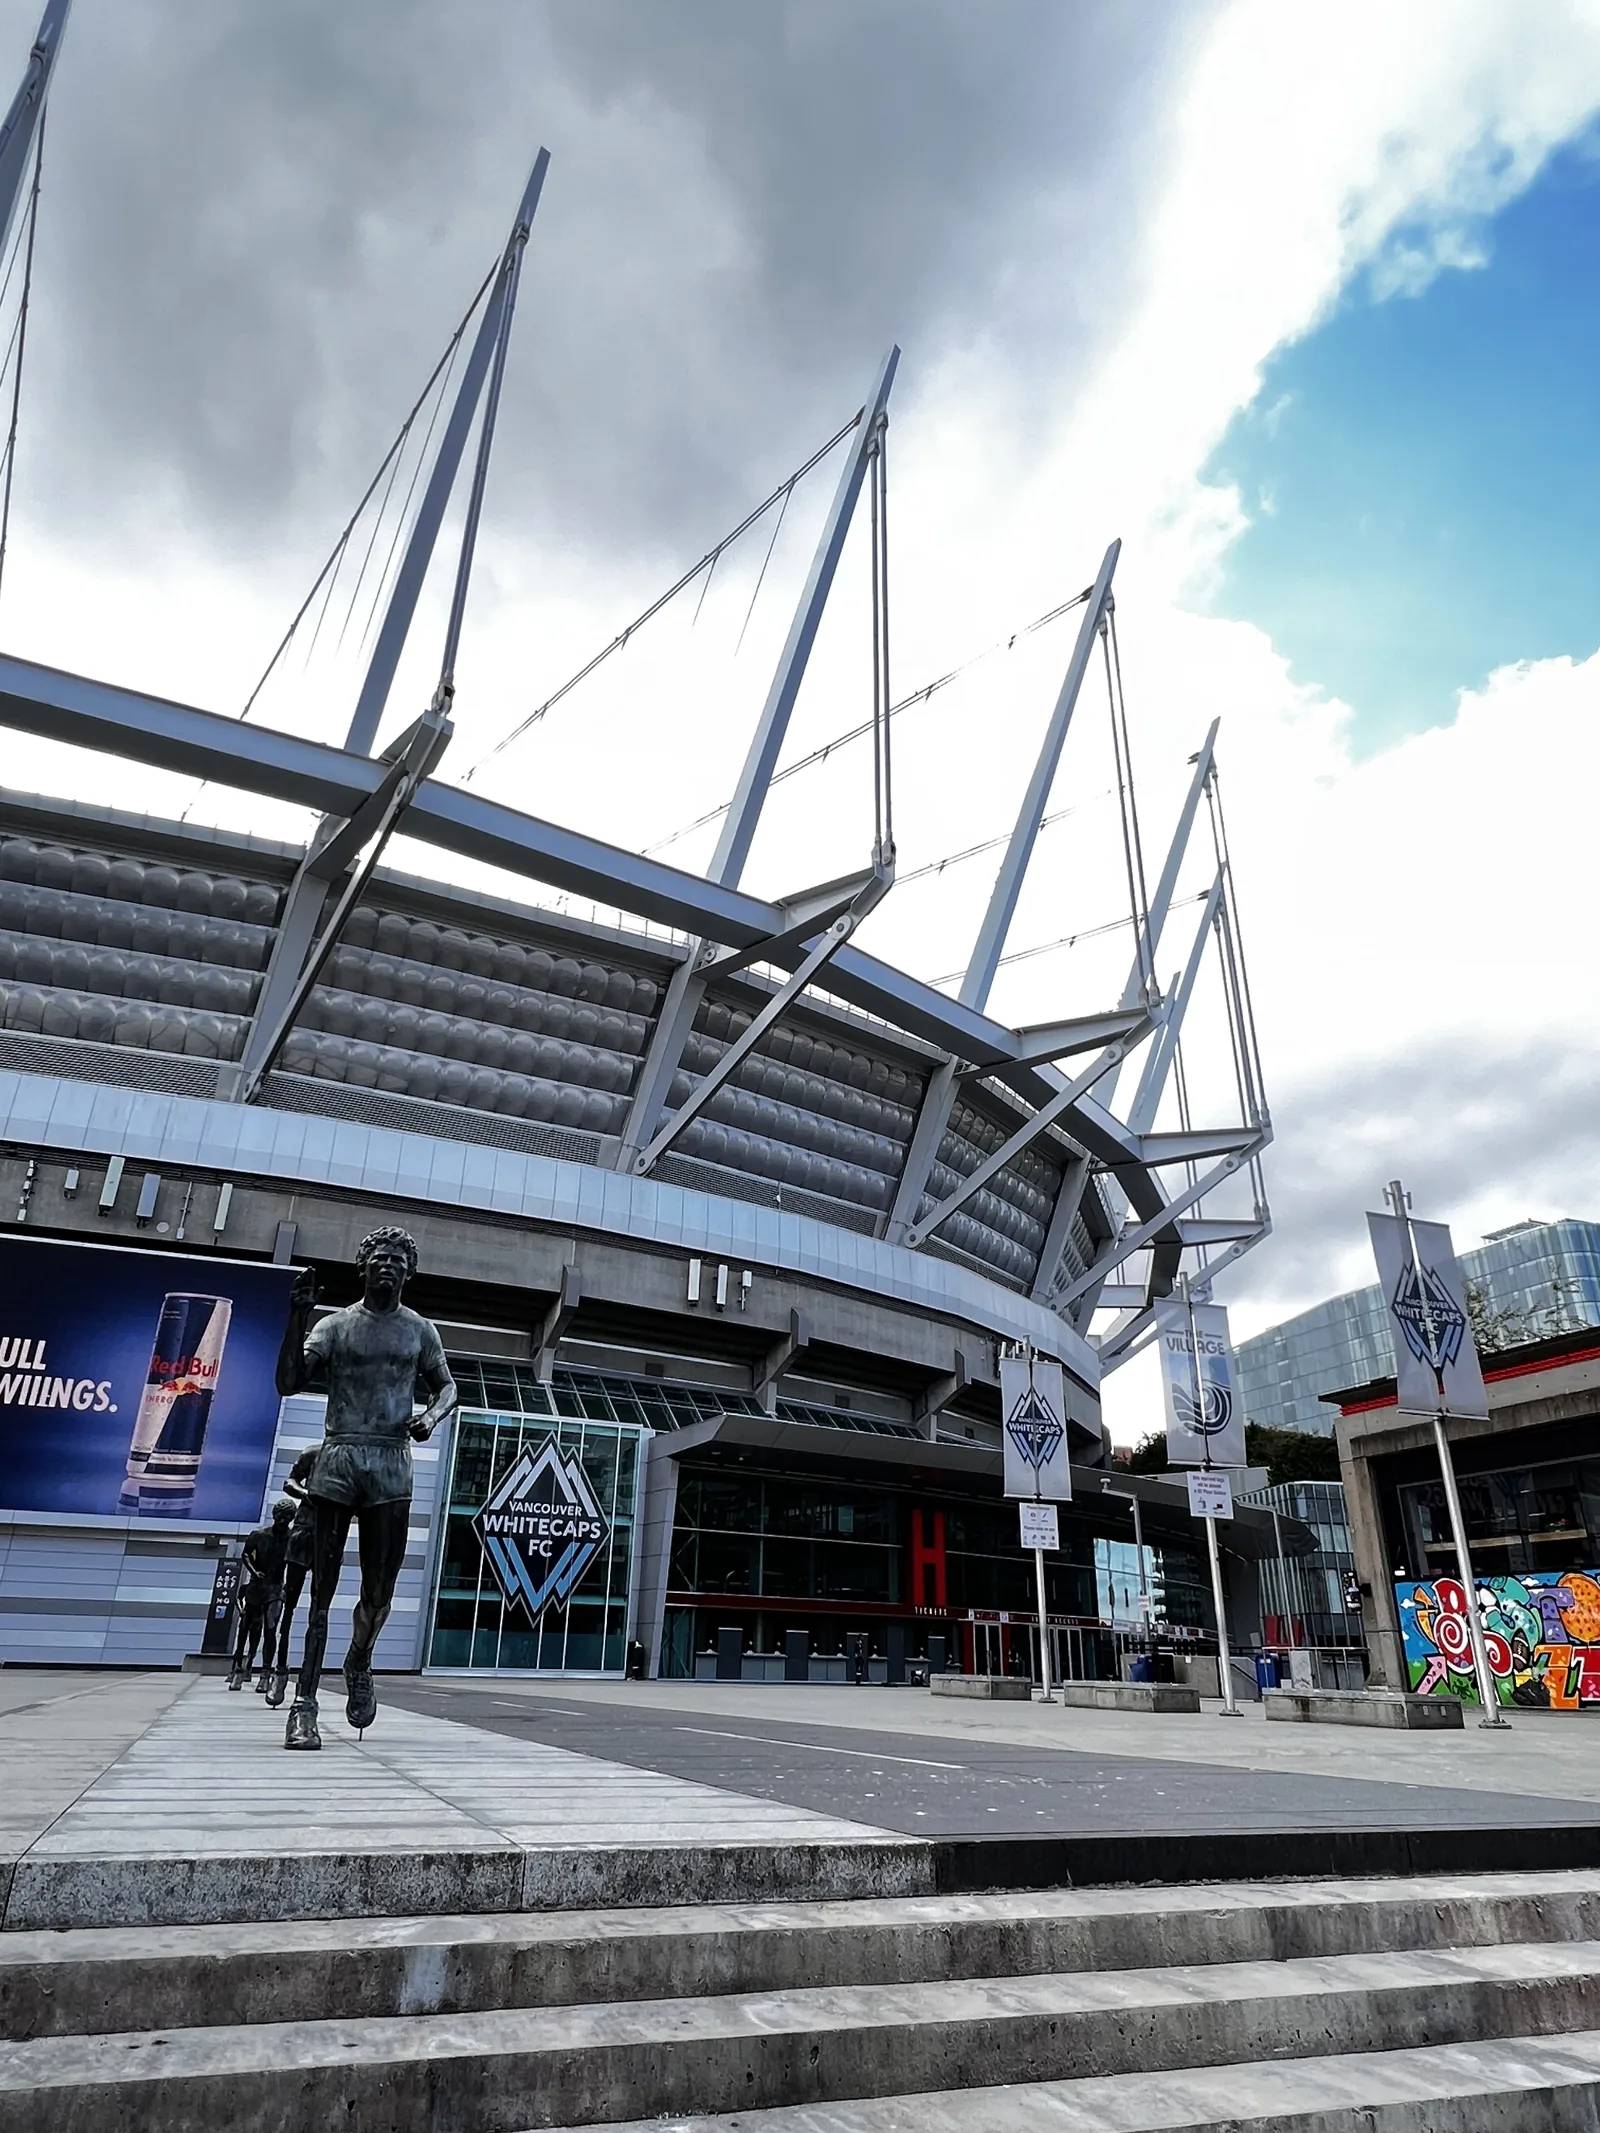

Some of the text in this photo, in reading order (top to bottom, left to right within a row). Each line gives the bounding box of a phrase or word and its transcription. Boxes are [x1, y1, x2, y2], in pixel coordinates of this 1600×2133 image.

[1394, 1303, 1463, 1324] WHITECAPS
[1418, 1321, 1440, 1334] FC
[1166, 1337, 1226, 1355] VILLAGE
[152, 1354, 219, 1378] Red Bull
[1008, 1422, 1061, 1435] WHITECAPS
[1028, 1433, 1042, 1443] FC
[509, 1501, 583, 1517] VANCOUVER
[482, 1514, 601, 1539] WHITECAPS
[528, 1539, 553, 1557] FC
[912, 1508, 947, 1606] H
